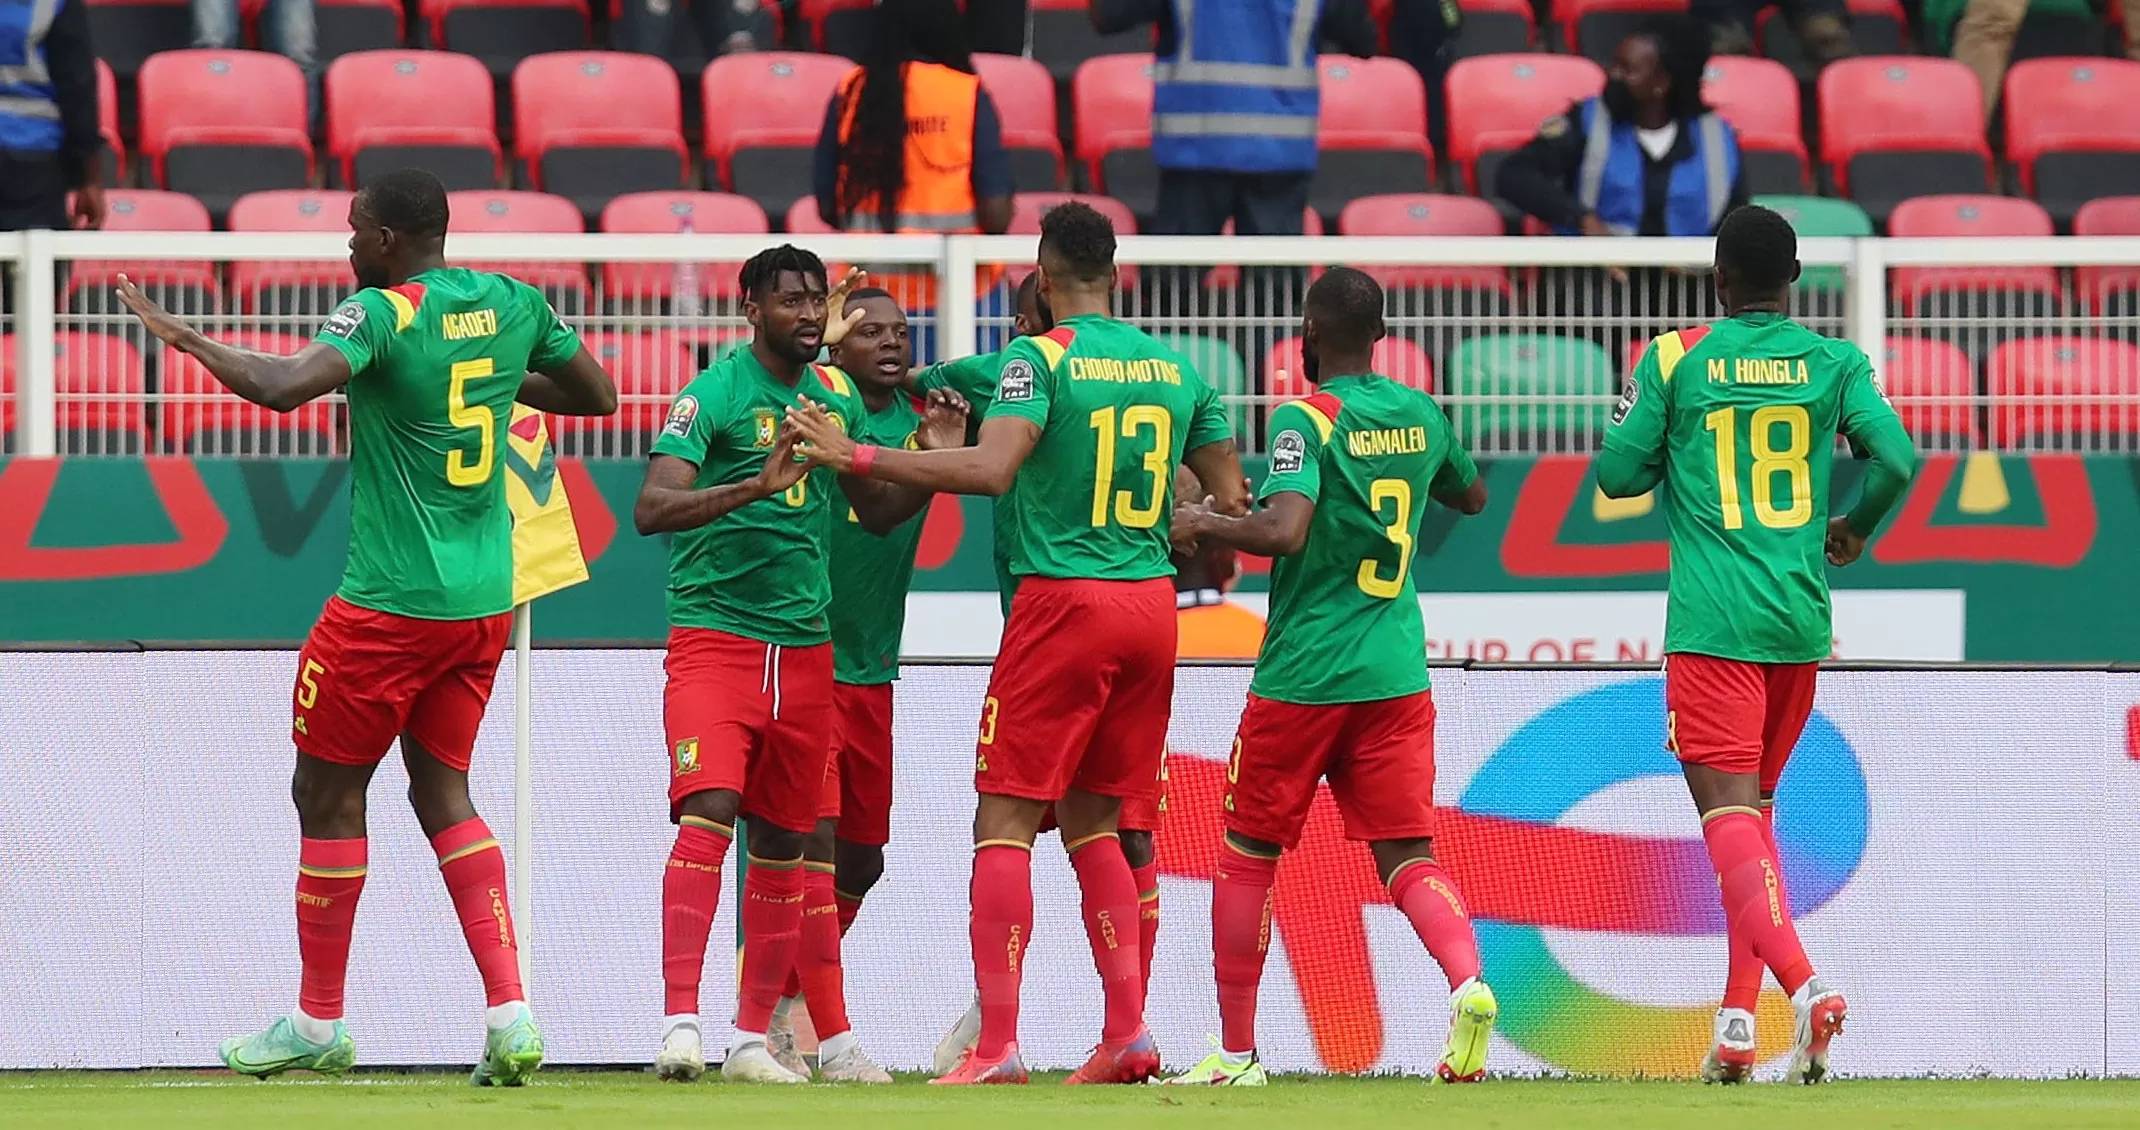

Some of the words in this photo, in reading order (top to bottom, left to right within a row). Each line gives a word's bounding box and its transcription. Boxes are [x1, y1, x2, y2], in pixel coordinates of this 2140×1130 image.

[442, 309, 497, 339] NGADEU
[1707, 358, 1728, 383] M.
[1735, 359, 1808, 384] HONGLA
[446, 357, 494, 486] 5
[1348, 426, 1426, 457] NGAMALEU
[1090, 404, 1171, 528] 13
[1705, 404, 1812, 530] 18
[1356, 478, 1412, 599] 3
[297, 658, 325, 710] 5
[980, 696, 999, 745] 3
